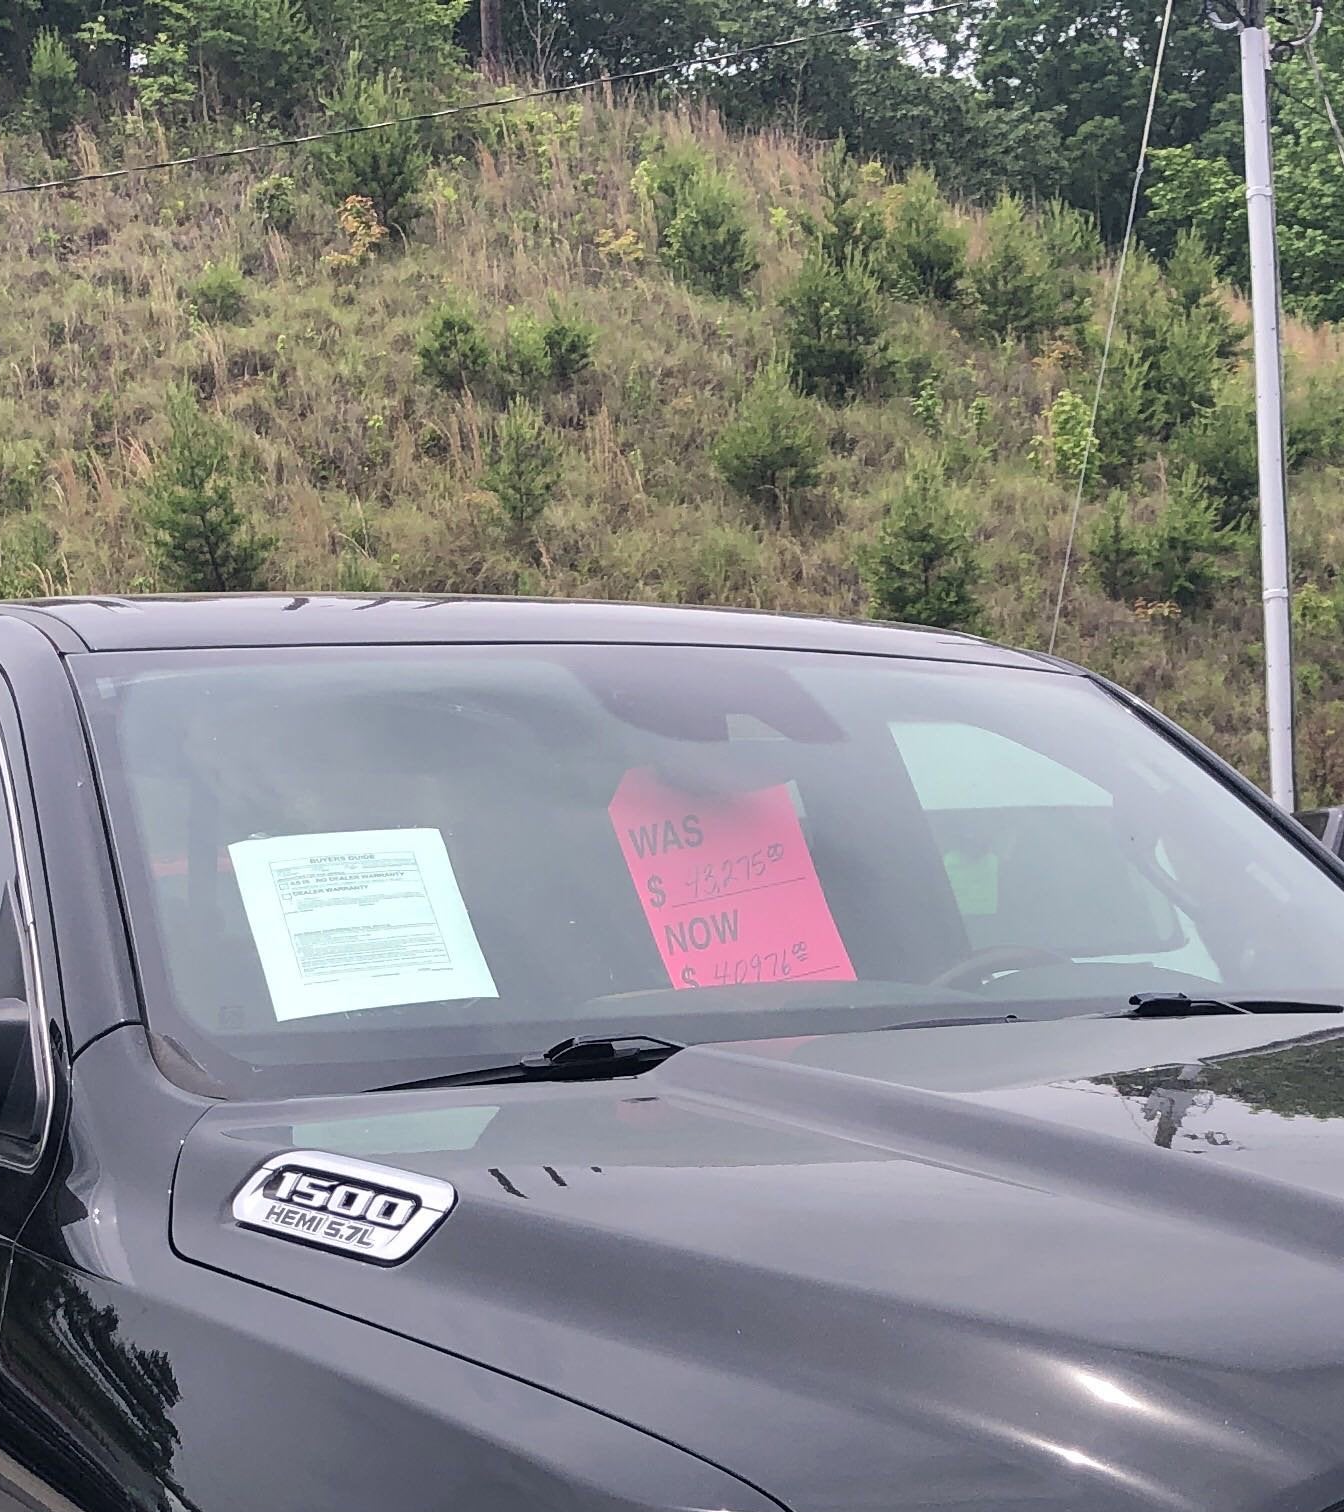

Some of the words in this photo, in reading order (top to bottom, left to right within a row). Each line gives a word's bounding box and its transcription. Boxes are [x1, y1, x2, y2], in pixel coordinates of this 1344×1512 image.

[627, 814, 704, 860] WAS
[309, 856, 346, 864] BUYERS
[361, 871, 405, 880] WARRANTY
[292, 887, 324, 897] DEALER
[326, 885, 369, 893] WARRANTY
[647, 874, 667, 911] $
[664, 908, 740, 956] NOW
[274, 1170, 418, 1227] 1500
[265, 1204, 323, 1233] HEMI
[323, 1219, 374, 1247] 5.7L
